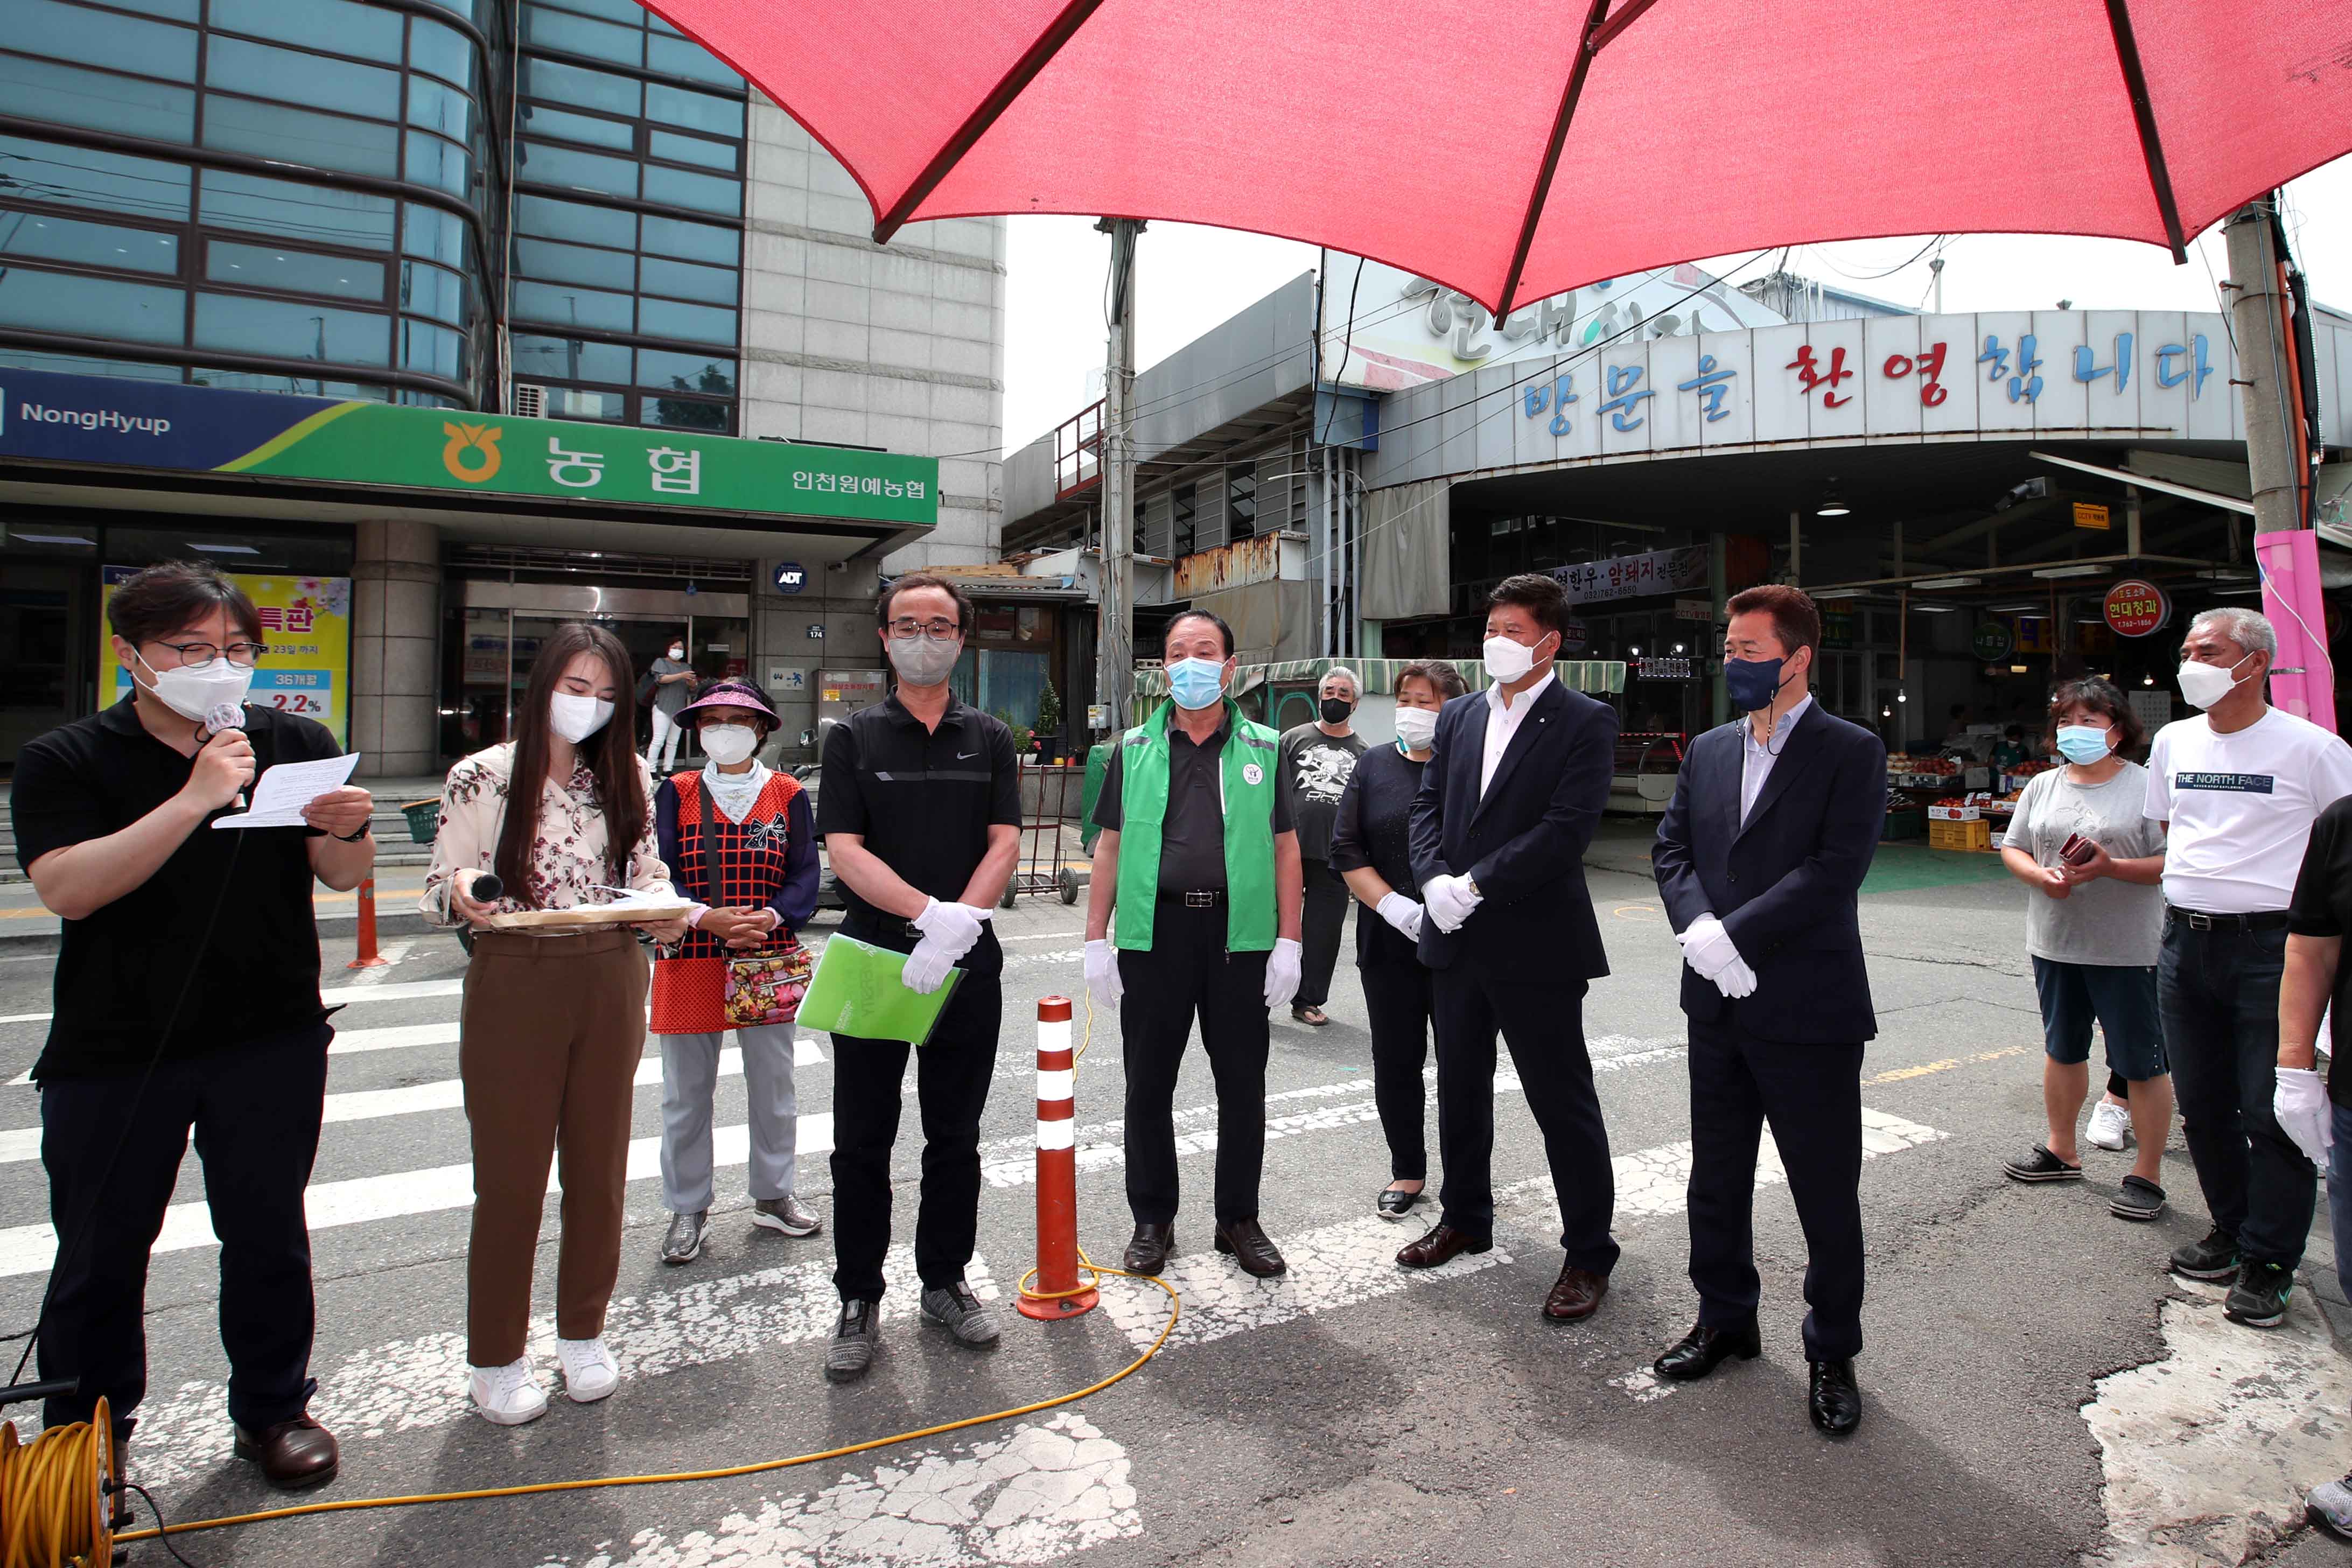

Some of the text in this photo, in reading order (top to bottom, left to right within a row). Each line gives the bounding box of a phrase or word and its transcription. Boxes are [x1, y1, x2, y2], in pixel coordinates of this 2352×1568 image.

[1524, 332, 2214, 436] 방문을 환영합니다
[22, 402, 171, 436] NongHyup
[546, 436, 701, 495] 농협
[792, 470, 926, 499] 인천원예농협
[778, 571, 802, 584] ADT
[1657, 559, 1689, 579] 전문점
[2109, 599, 2157, 618] 현대청과
[274, 645, 296, 654] 23일
[299, 645, 318, 654] 까지
[276, 674, 317, 685] 36개월
[2178, 774, 2272, 787] THE NORTH FACE
